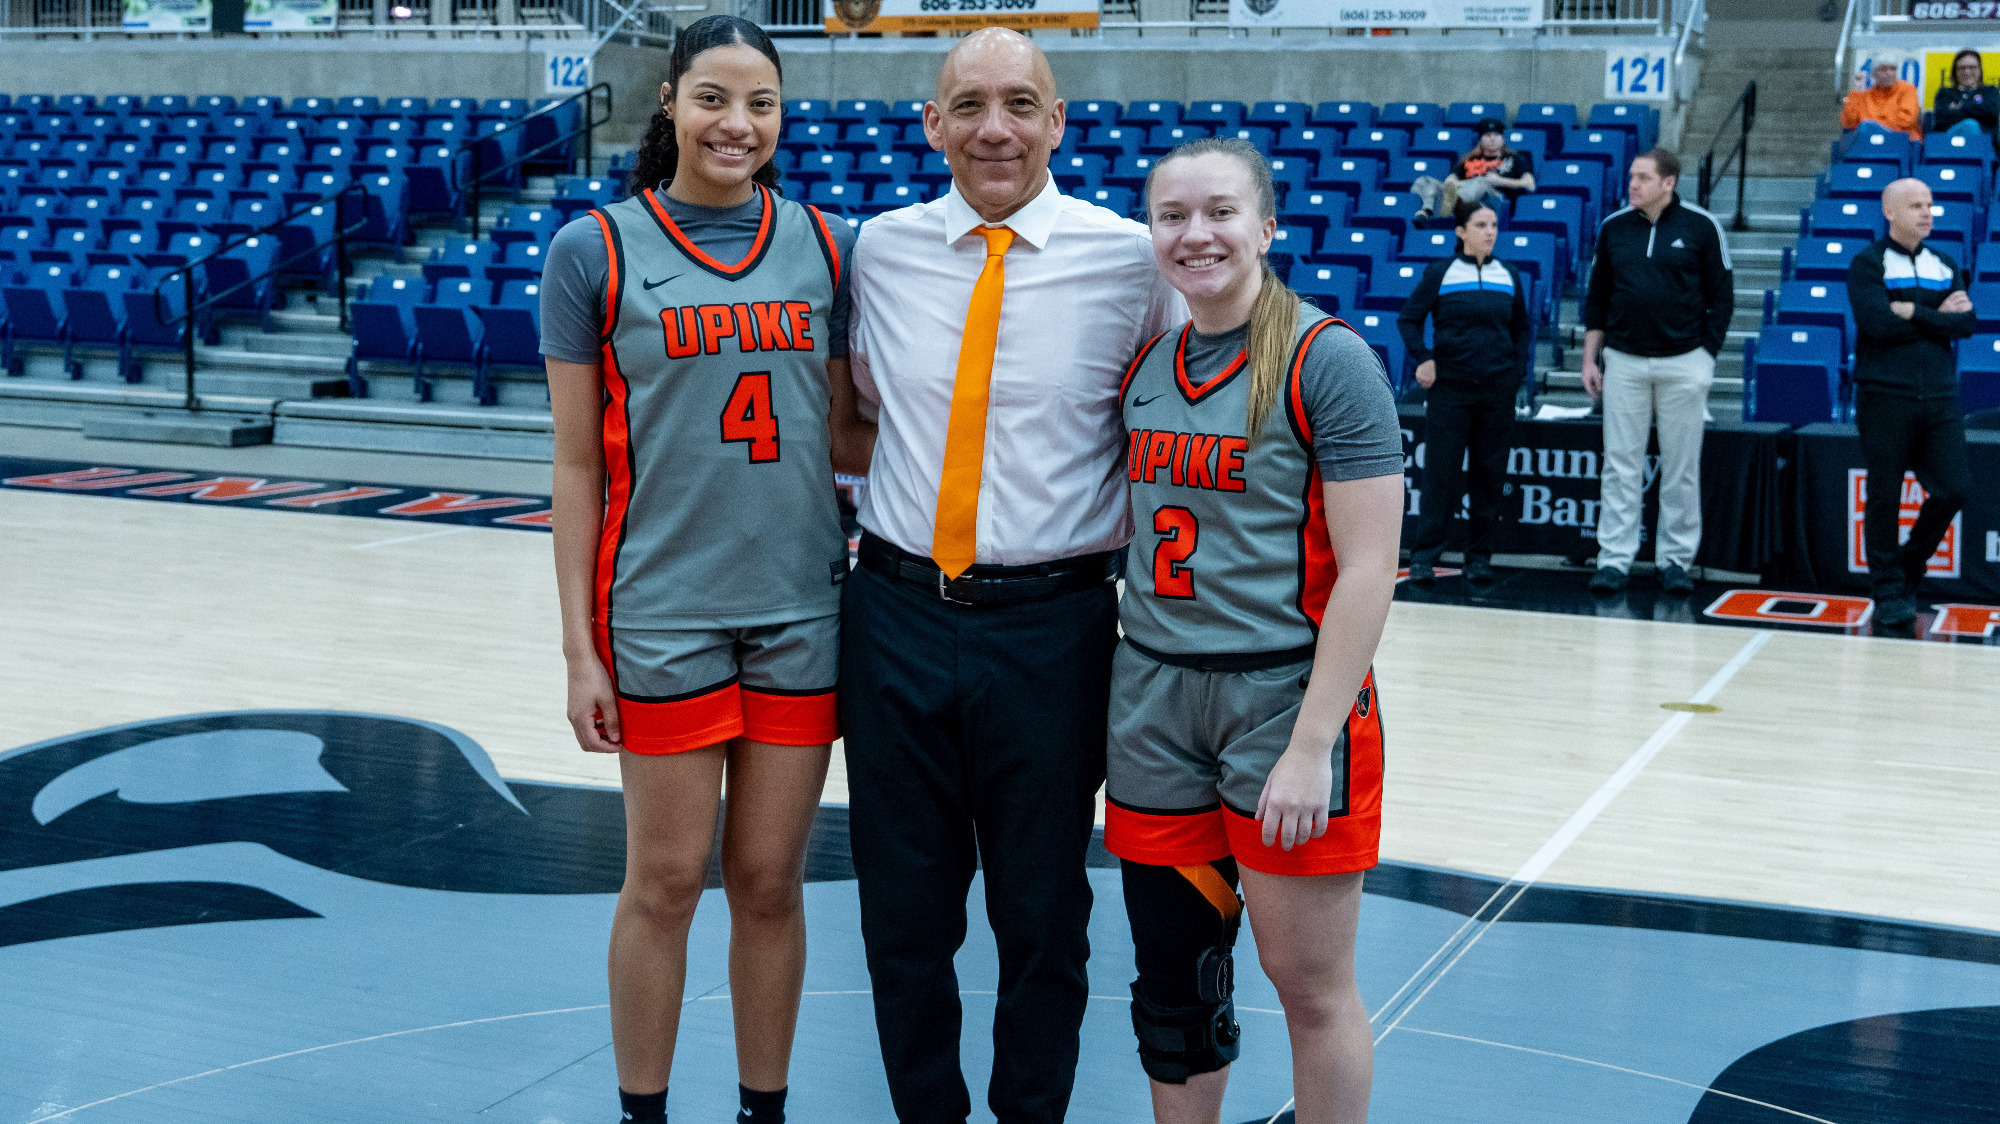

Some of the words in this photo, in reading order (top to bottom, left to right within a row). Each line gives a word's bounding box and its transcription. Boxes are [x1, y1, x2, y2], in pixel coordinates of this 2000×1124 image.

[1913, 2, 2000, 19] 606-37
[550, 56, 587, 86] 122
[1611, 57, 1665, 92] 121
[1860, 58, 1920, 89] 10
[659, 301, 814, 360] UPIKE
[720, 371, 780, 465] 4
[1128, 428, 1248, 493] UPIKE
[1153, 504, 1199, 601] 2
